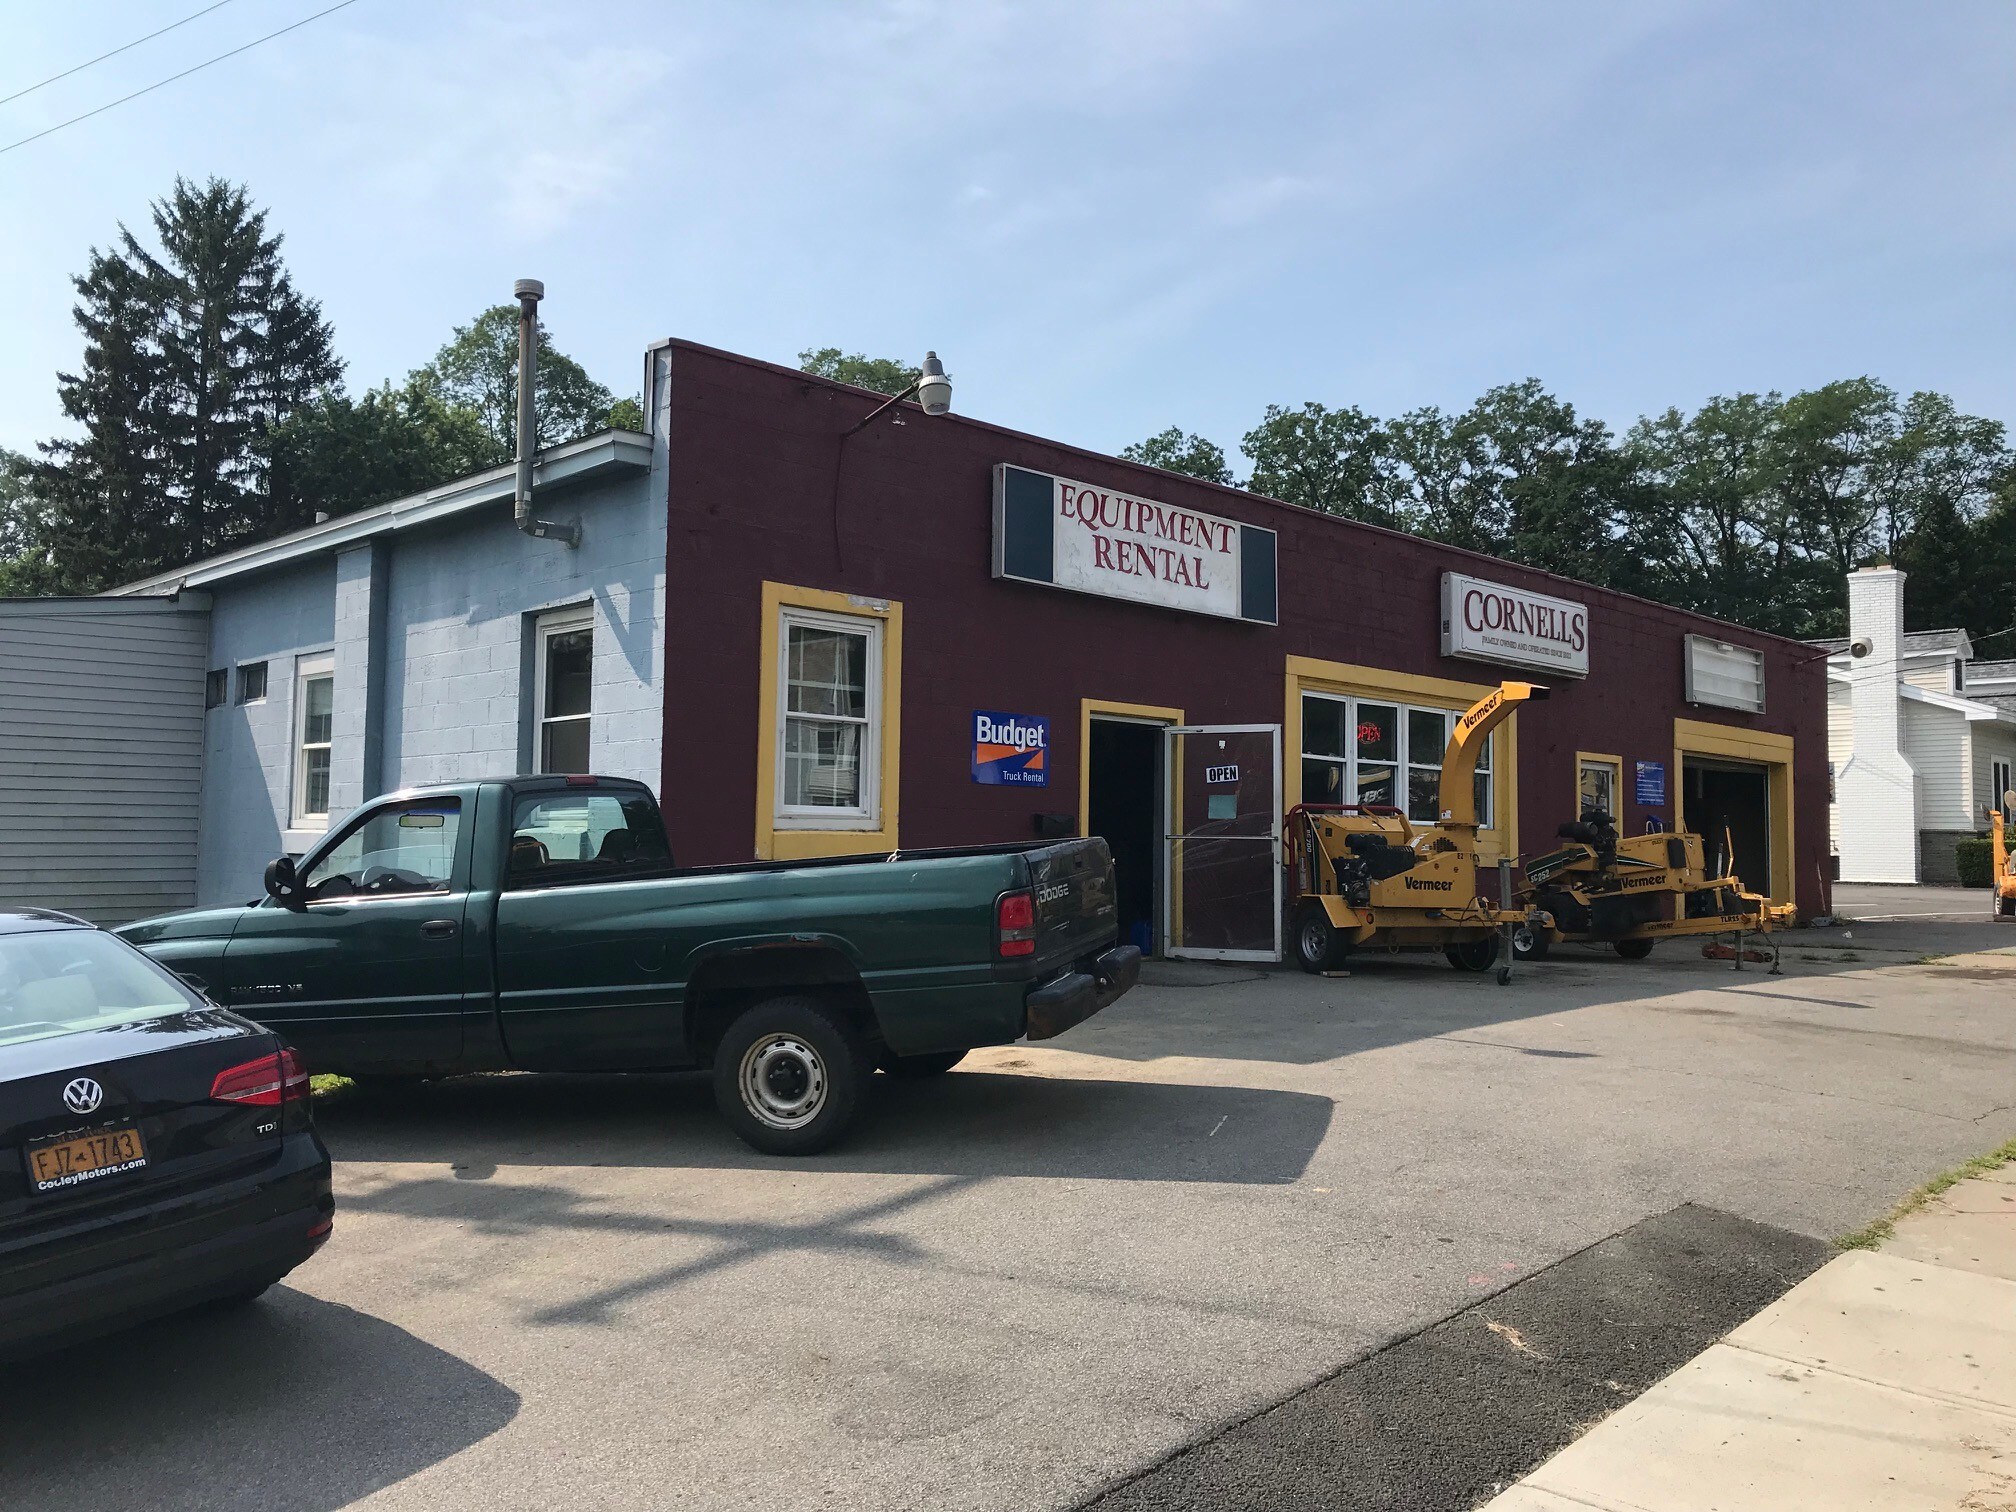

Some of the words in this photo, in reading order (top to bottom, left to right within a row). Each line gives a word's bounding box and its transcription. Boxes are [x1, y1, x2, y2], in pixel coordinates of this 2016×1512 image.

[1060, 483, 1236, 554] EQUIPMENT
[1092, 534, 1210, 590] RENTAL
[1464, 589, 1585, 652] CORNELLS
[1517, 643, 1528, 651] AND
[1463, 694, 1499, 730] Vermeer
[977, 715, 1044, 753] Budget
[1003, 770, 1022, 781] Truck
[1023, 772, 1044, 783] Rental
[1208, 766, 1237, 782] OPEN
[1404, 876, 1453, 891] Vermeer
[1621, 874, 1667, 889] Vermeer
[1039, 883, 1070, 903] DODGE
